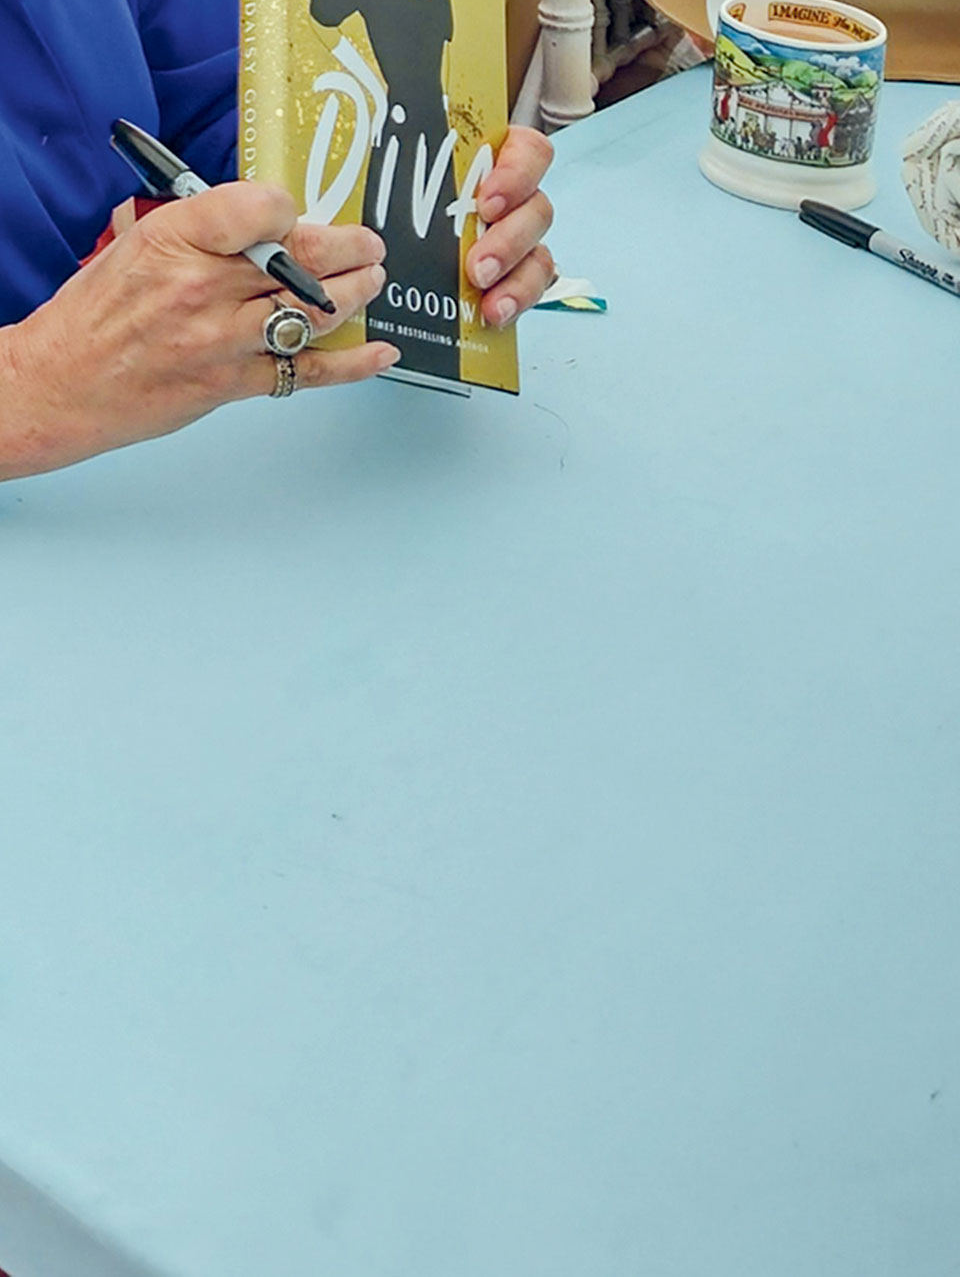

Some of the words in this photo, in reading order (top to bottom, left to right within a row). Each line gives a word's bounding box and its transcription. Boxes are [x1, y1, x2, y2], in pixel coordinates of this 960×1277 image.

[772, 4, 832, 26] IMAGINE
[244, 2, 257, 73] DAISY
[368, 317, 395, 333] TIMES
[397, 324, 453, 346] BESTSELLING
